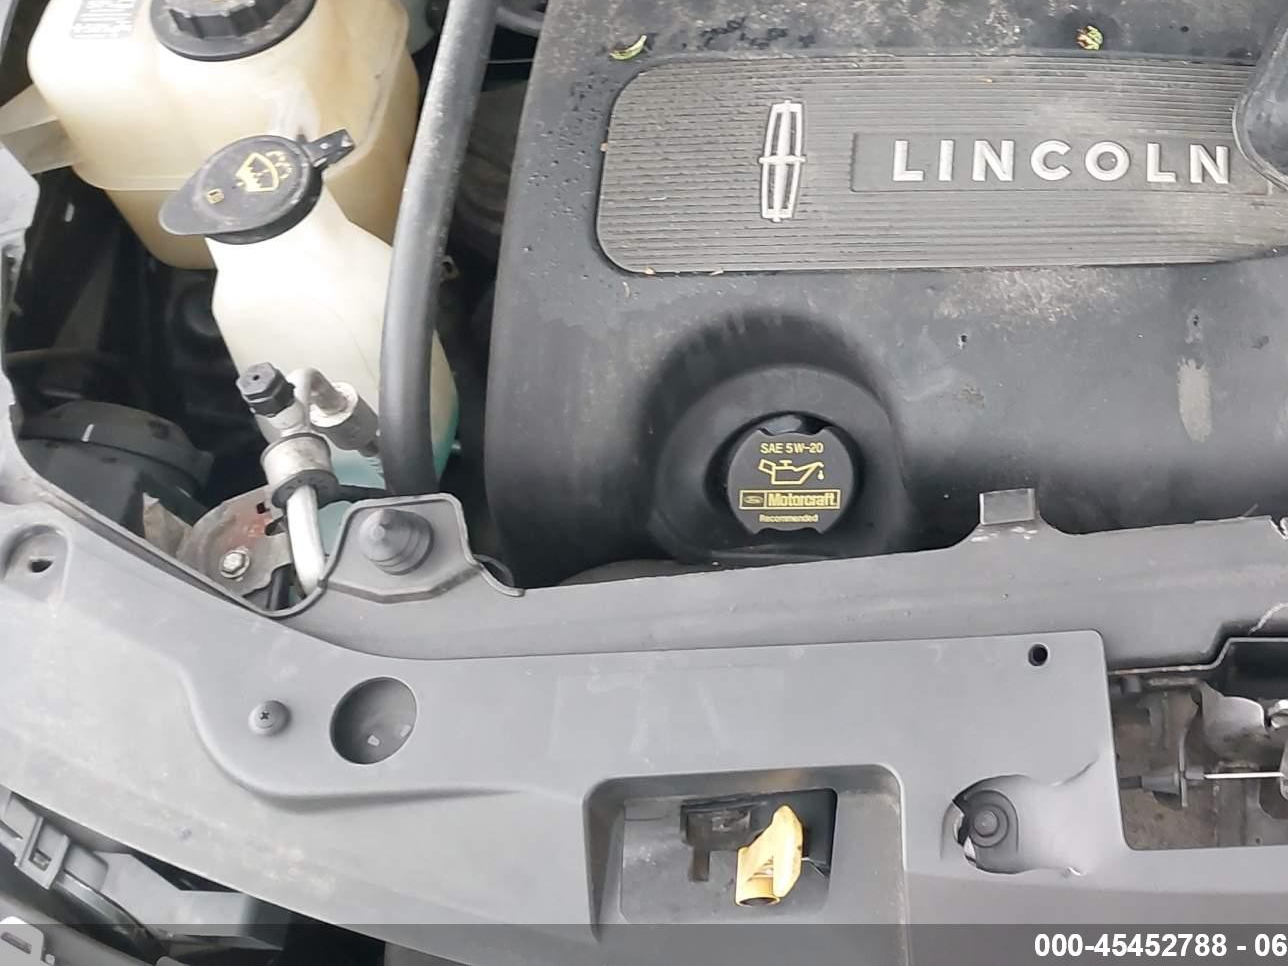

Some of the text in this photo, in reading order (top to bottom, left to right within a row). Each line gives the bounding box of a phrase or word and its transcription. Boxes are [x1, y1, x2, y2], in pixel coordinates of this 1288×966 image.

[892, 138, 1232, 185] LINCOLN
[760, 442, 824, 454] SAE 5W-20
[768, 492, 836, 507] Motorcraft
[759, 513, 819, 523] Recommended
